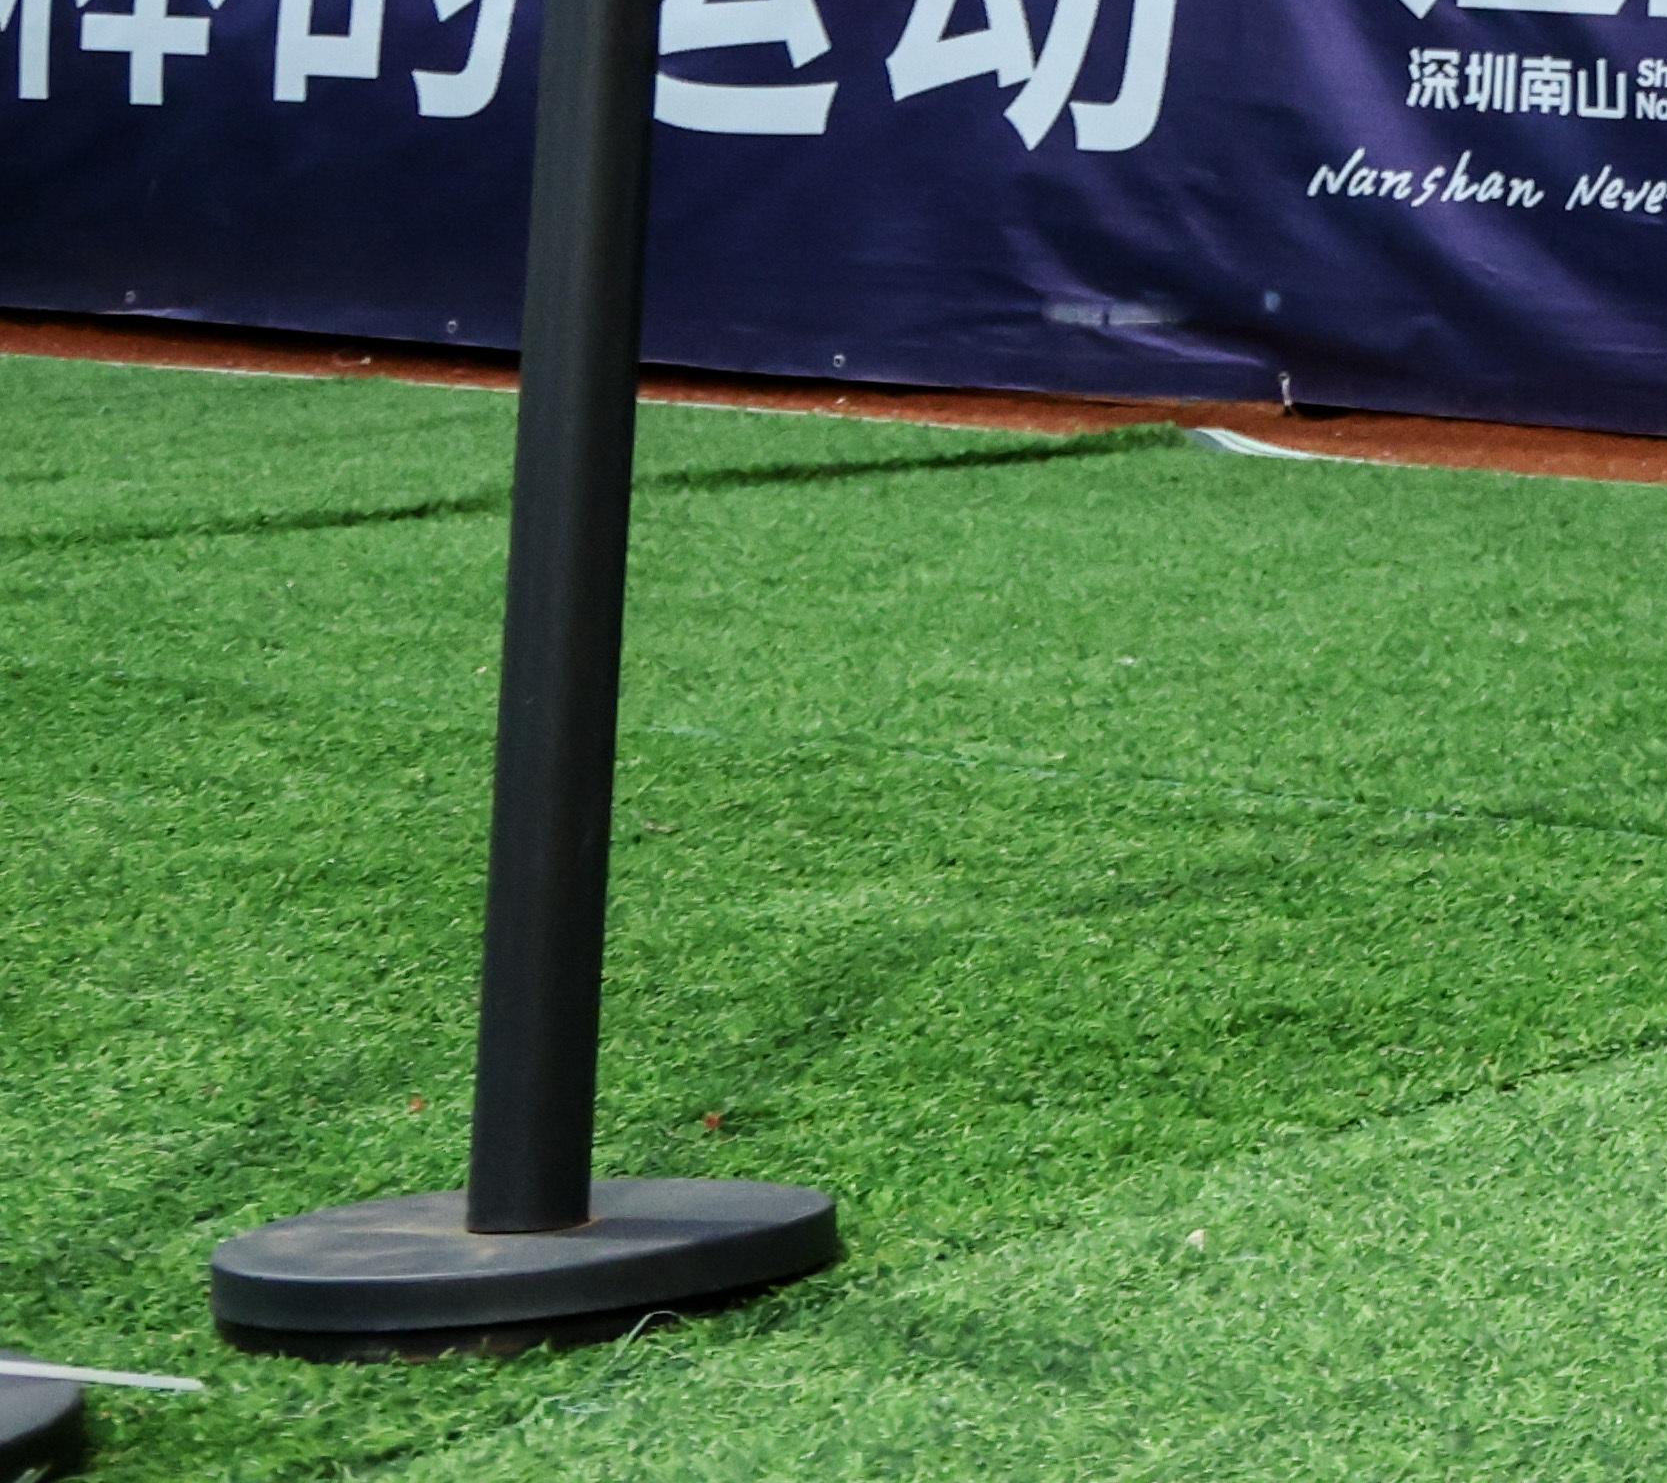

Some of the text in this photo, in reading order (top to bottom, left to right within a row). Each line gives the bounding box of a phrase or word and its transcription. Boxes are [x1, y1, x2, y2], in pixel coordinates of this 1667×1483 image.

[1405, 46, 1628, 121] 深圳南山
[1306, 146, 1545, 209] Nanshan
